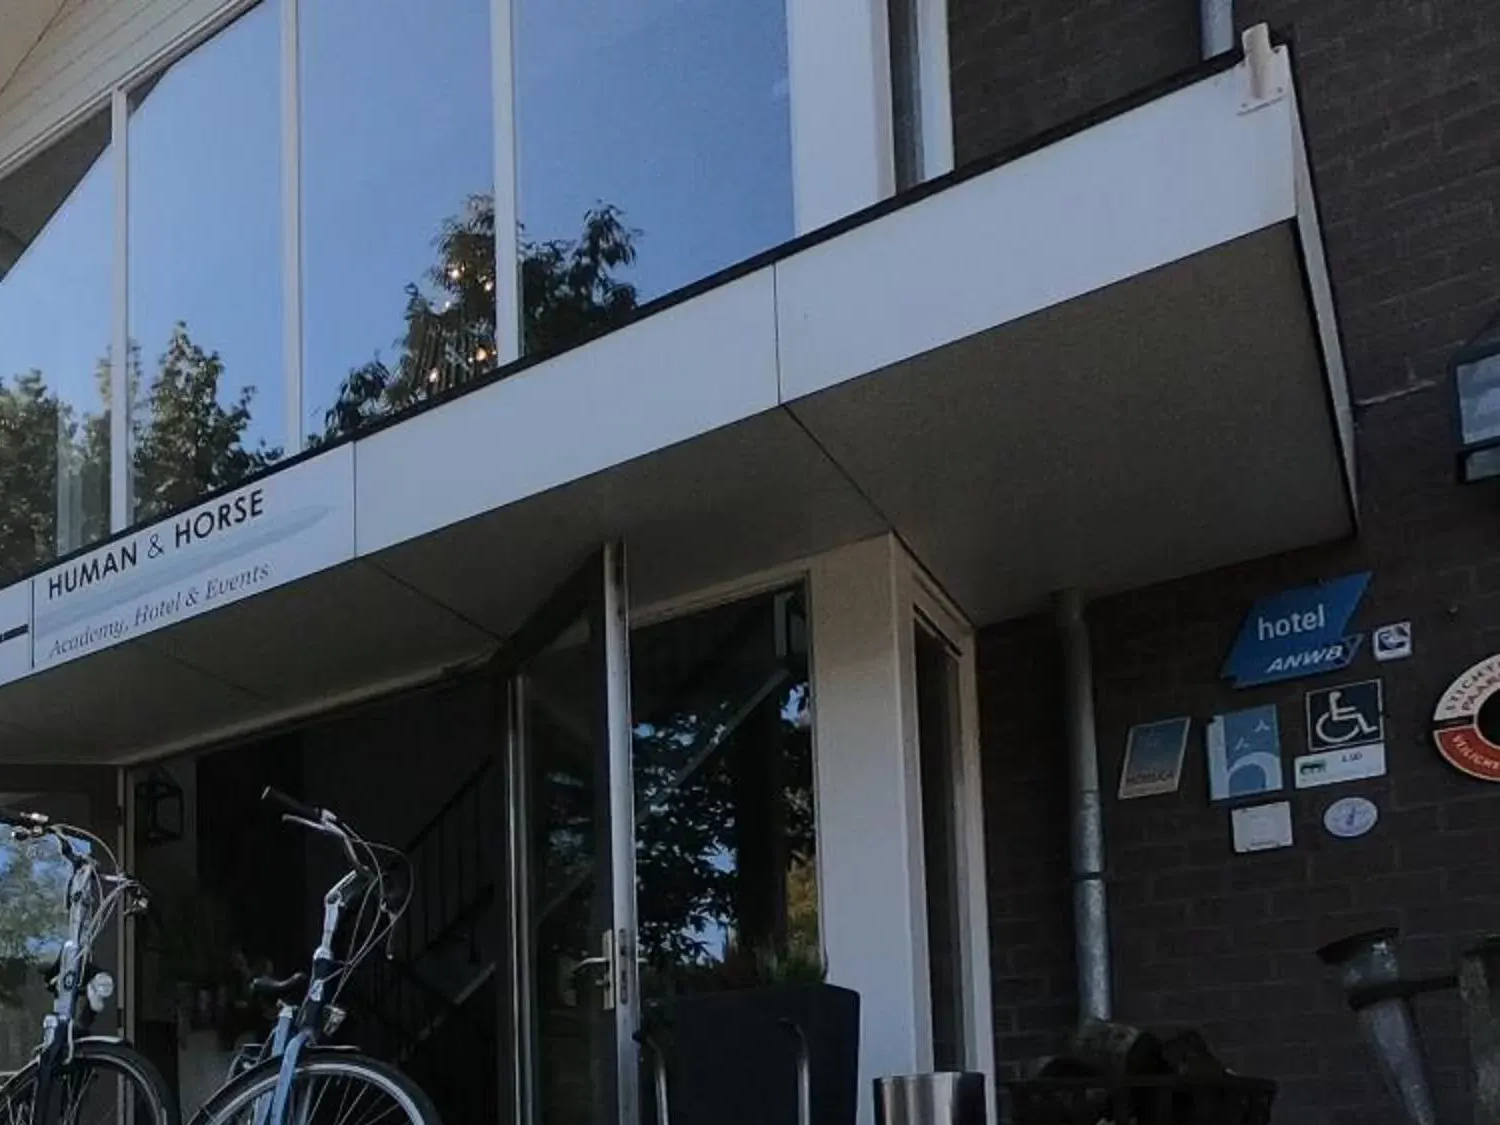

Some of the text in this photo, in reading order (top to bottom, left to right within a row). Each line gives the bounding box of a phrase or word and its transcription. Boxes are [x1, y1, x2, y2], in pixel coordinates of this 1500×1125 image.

[49, 488, 264, 600] HUMAN & HORSE
[49, 562, 270, 659] Academy, Hotel & Events
[1257, 603, 1326, 641] hotel
[1265, 645, 1344, 675] ANWB
